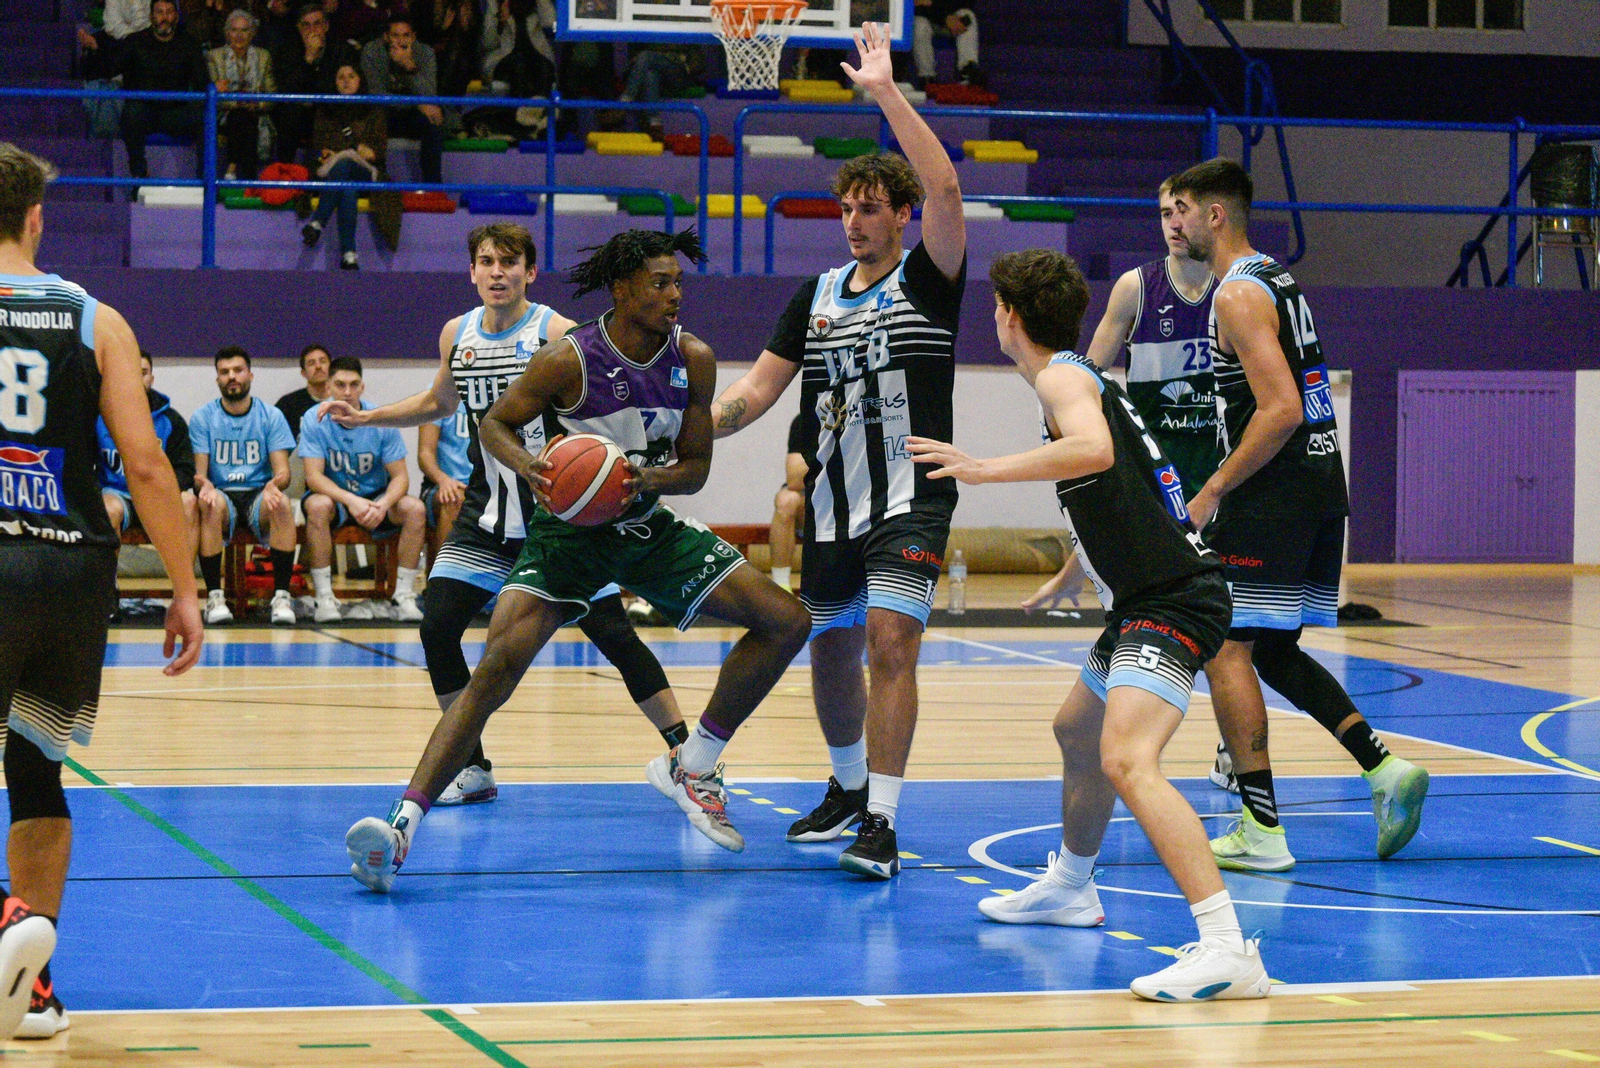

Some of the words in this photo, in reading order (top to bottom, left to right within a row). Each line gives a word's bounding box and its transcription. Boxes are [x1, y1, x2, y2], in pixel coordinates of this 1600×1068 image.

[1182, 341, 1212, 371] 23
[0, 346, 49, 435] 8
[640, 410, 657, 432] 7
[214, 438, 261, 466] ULB
[327, 447, 375, 476] ULB
[883, 434, 912, 461] 14
[0, 471, 60, 511] BAGO
[1142, 620, 1171, 635] Ruiz
[1137, 643, 1162, 671] 5
